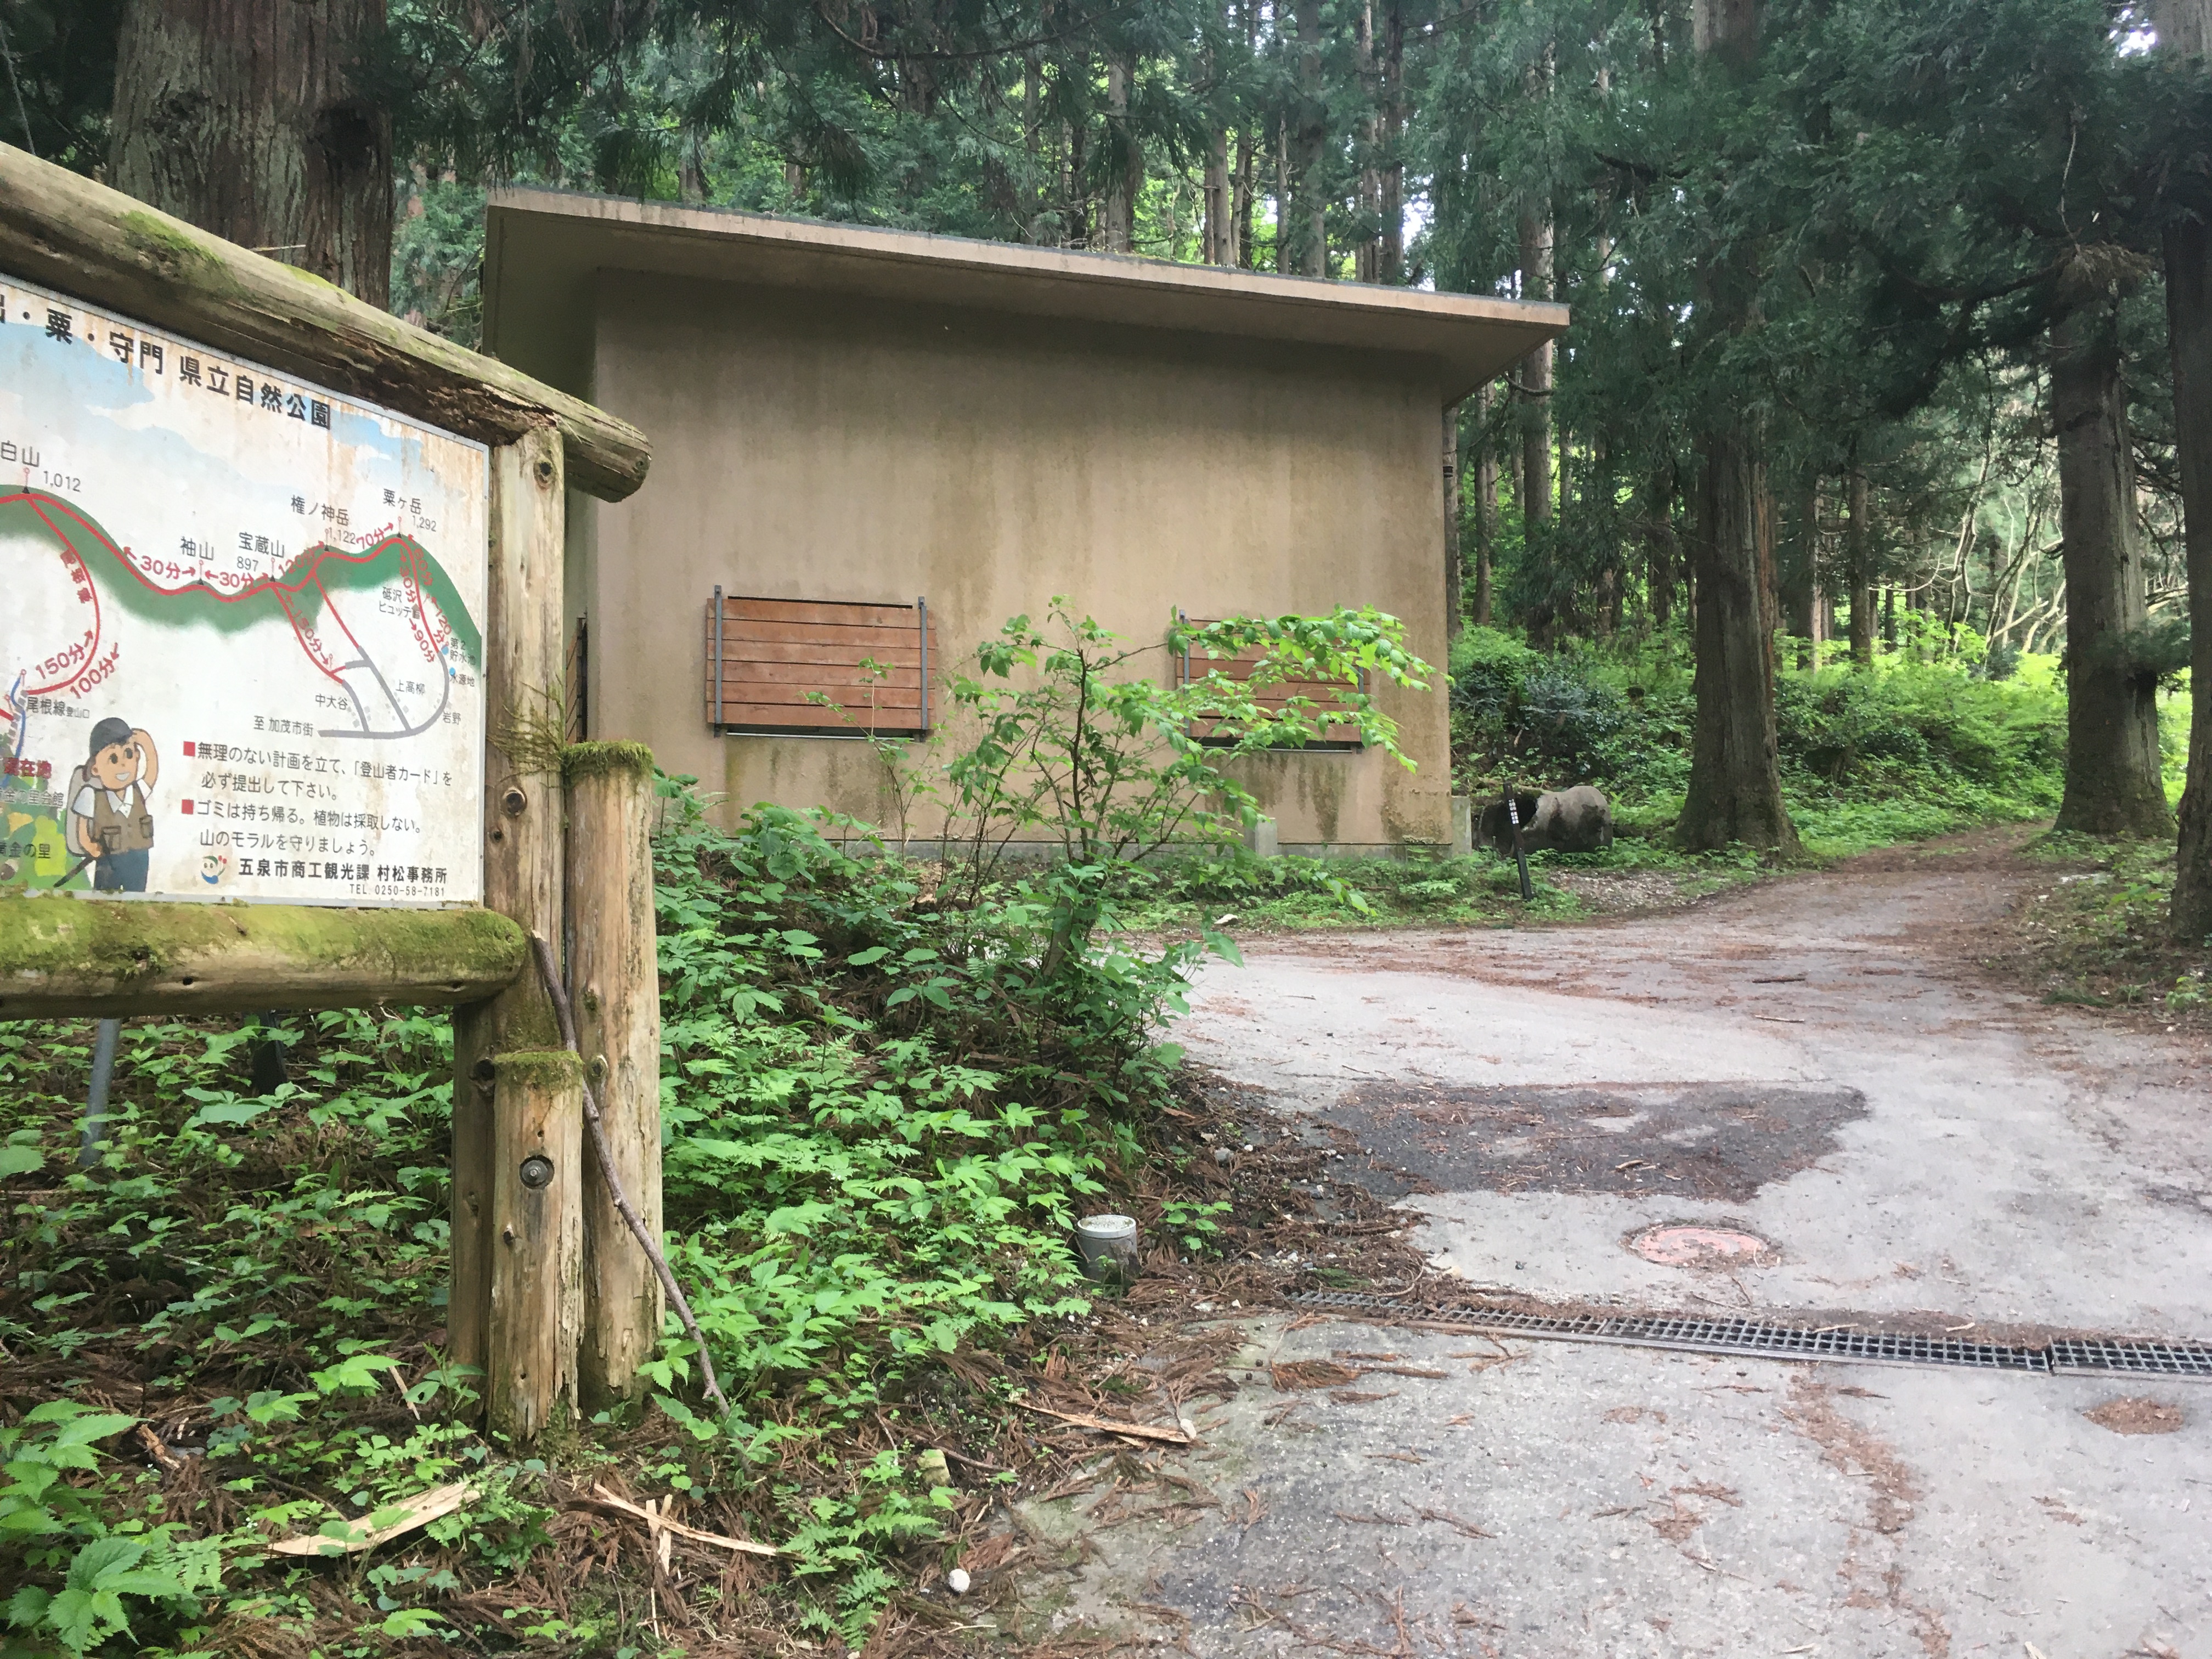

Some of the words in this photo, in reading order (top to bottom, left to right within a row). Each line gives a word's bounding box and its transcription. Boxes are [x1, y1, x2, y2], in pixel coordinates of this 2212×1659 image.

[179, 355, 330, 430] 県立自然公園
[1, 440, 40, 467] 白山
[43, 470, 81, 492] 1,012
[291, 494, 349, 526] 権ノ神岳
[329, 527, 356, 544] 1,122
[412, 515, 436, 532] 1,292
[180, 536, 214, 561] 袖山
[239, 532, 284, 558] 宝蔵山
[357, 527, 385, 549] 70分
[140, 555, 180, 579] 30分
[236, 556, 258, 572] 897
[219, 572, 254, 590] 30分
[399, 565, 417, 603] 30分
[379, 600, 411, 618] ヒュッテ
[414, 630, 435, 663] 90分
[36, 642, 85, 679] 150分
[70, 656, 115, 699] 100分
[315, 693, 348, 710] 中大谷
[253, 715, 264, 730] 至
[268, 717, 313, 737] 加茂市街
[198, 742, 452, 786] 無理のない計画を立て、「登山者カード」を
[0, 787, 64, 808] 金の里会館
[201, 771, 336, 800] 必ず提出して下さい。
[200, 829, 375, 856] 山のモラルを守りましょう。
[239, 858, 369, 881] 五泉市商工観光課
[377, 865, 447, 884] 村松事務所
[375, 885, 445, 896] 0250-58-7181
